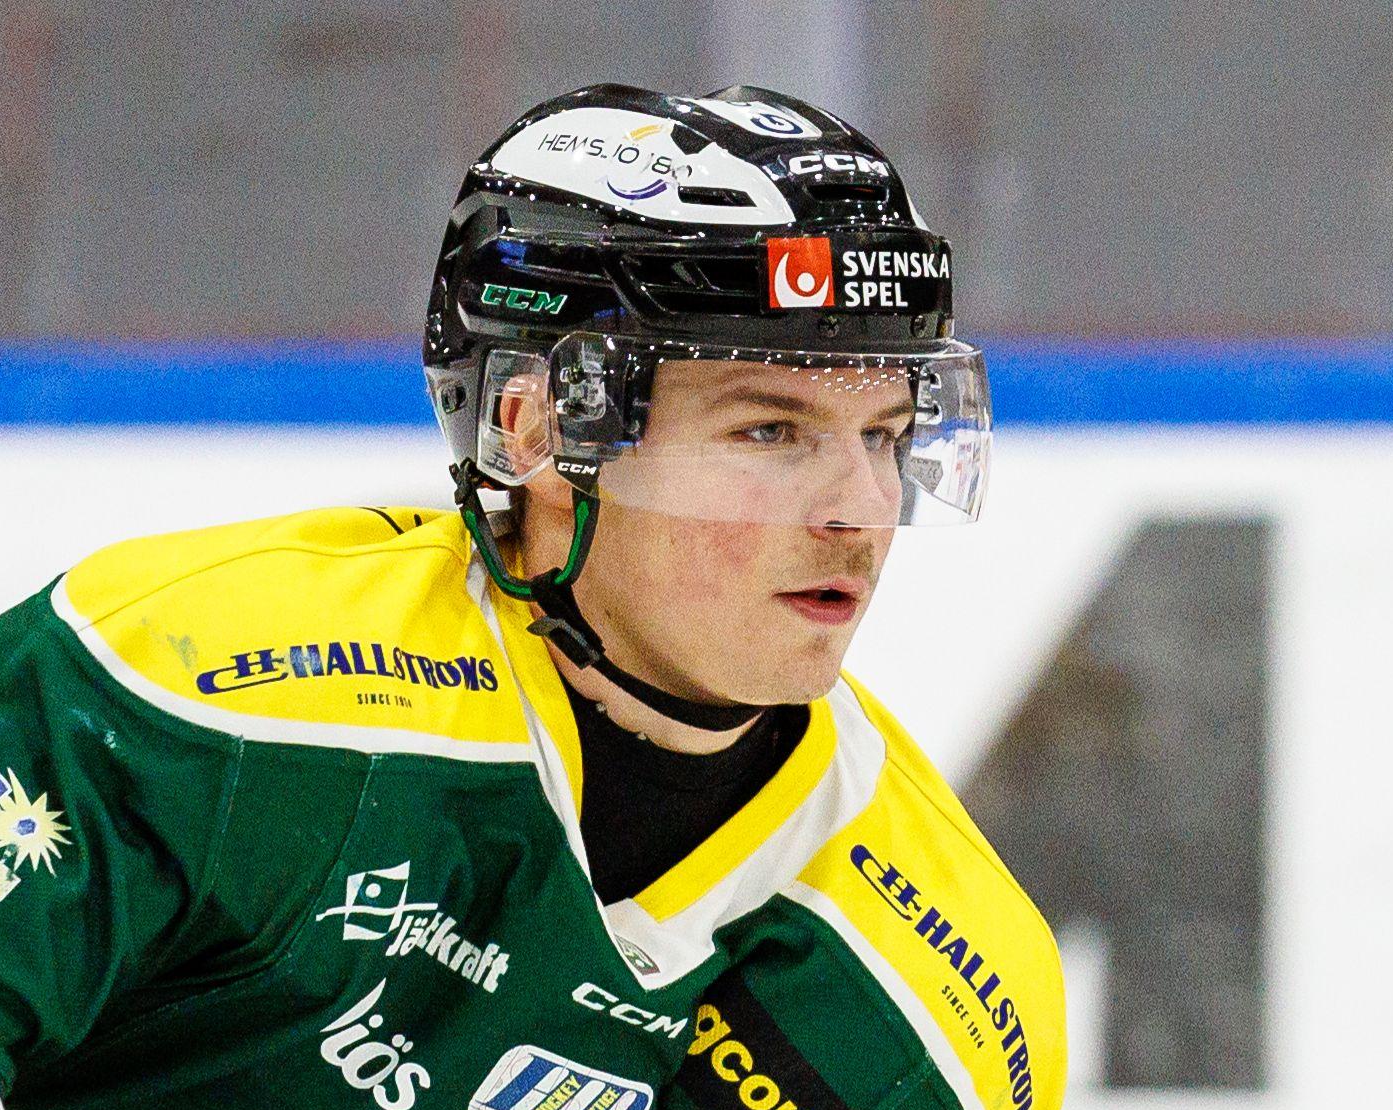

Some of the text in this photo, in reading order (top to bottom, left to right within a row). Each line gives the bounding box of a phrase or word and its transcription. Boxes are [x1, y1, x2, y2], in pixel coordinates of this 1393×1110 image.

[788, 154, 889, 176] CCM
[843, 250, 950, 278] SVENSKA
[481, 282, 567, 315] CCM
[844, 281, 908, 307] SPEL
[557, 462, 597, 475] CCM
[357, 693, 390, 706] SINCE
[571, 982, 688, 1040] CCM
[941, 985, 984, 1049] SINCE 1914
